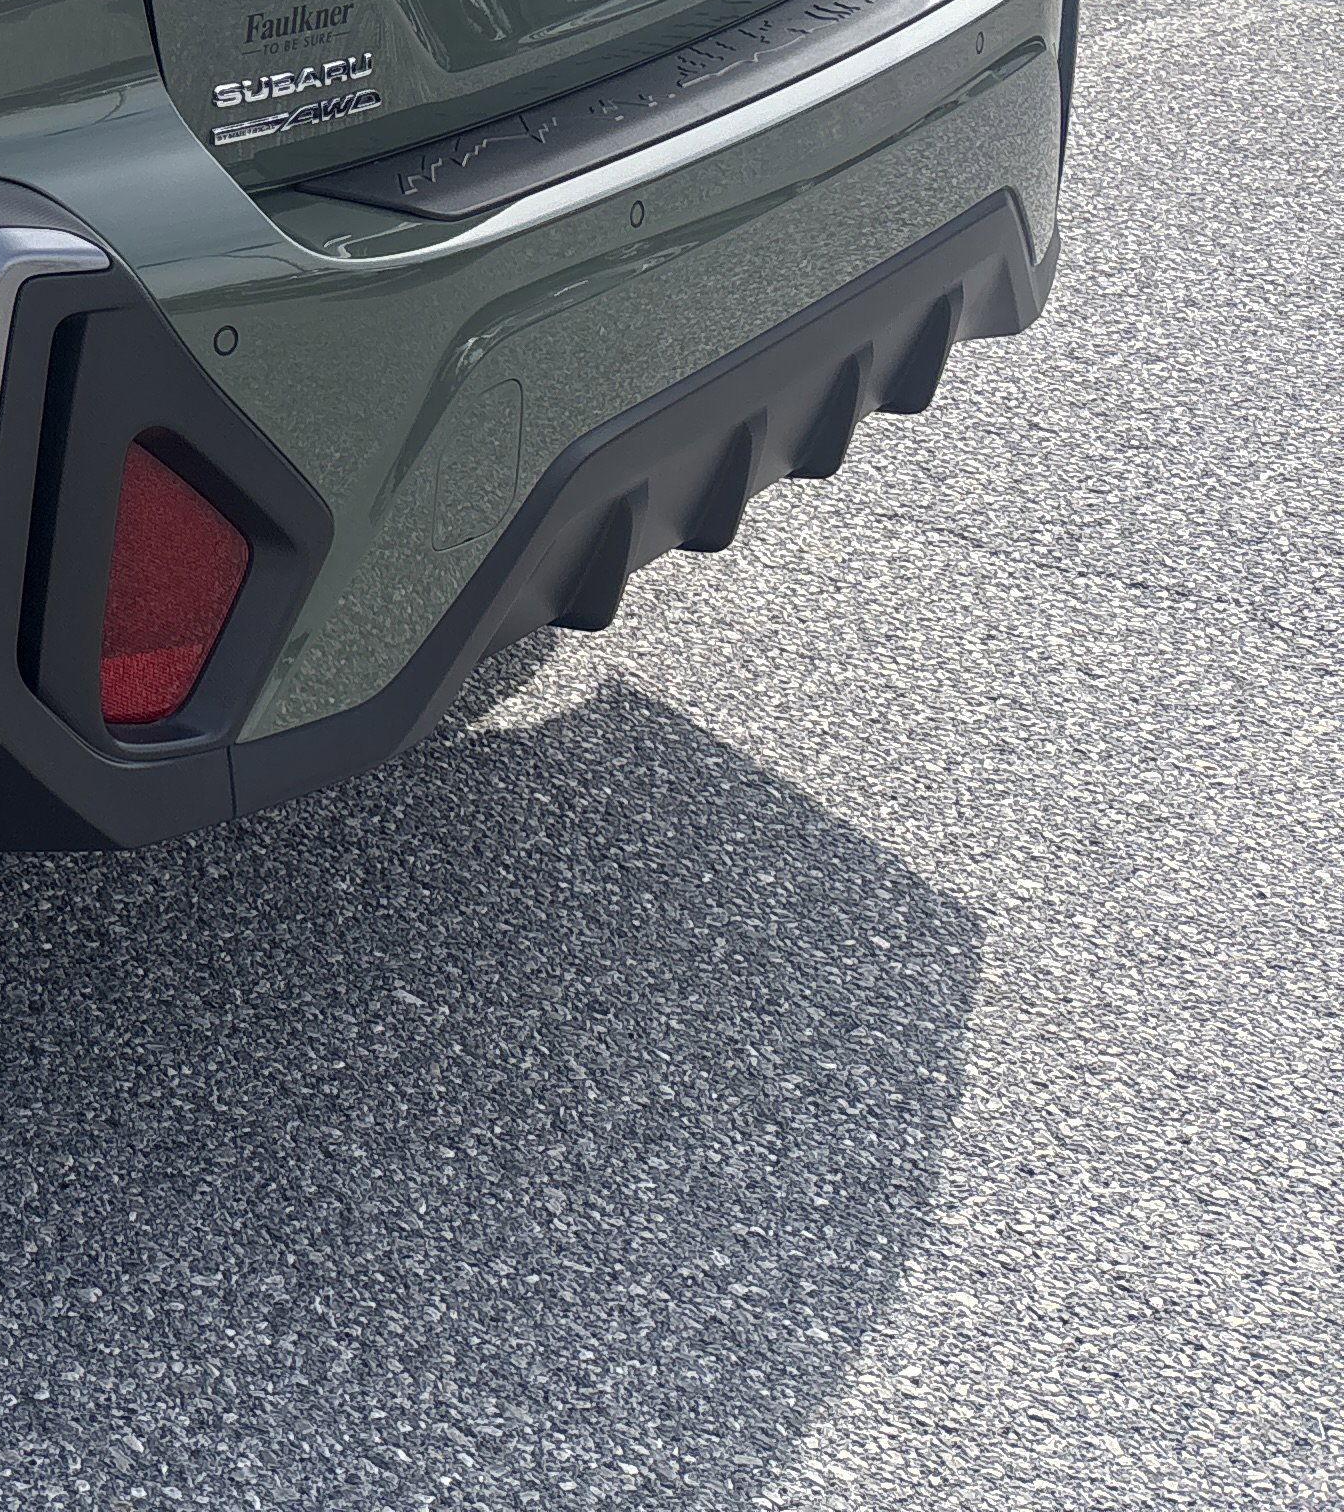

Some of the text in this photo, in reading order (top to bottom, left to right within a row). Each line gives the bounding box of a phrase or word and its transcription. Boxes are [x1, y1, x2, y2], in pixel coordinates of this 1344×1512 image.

[243, 2, 355, 45] Faulkner
[263, 31, 333, 55] TO BE SURE
[213, 52, 373, 108] SUBARU
[280, 88, 383, 132] AWD
